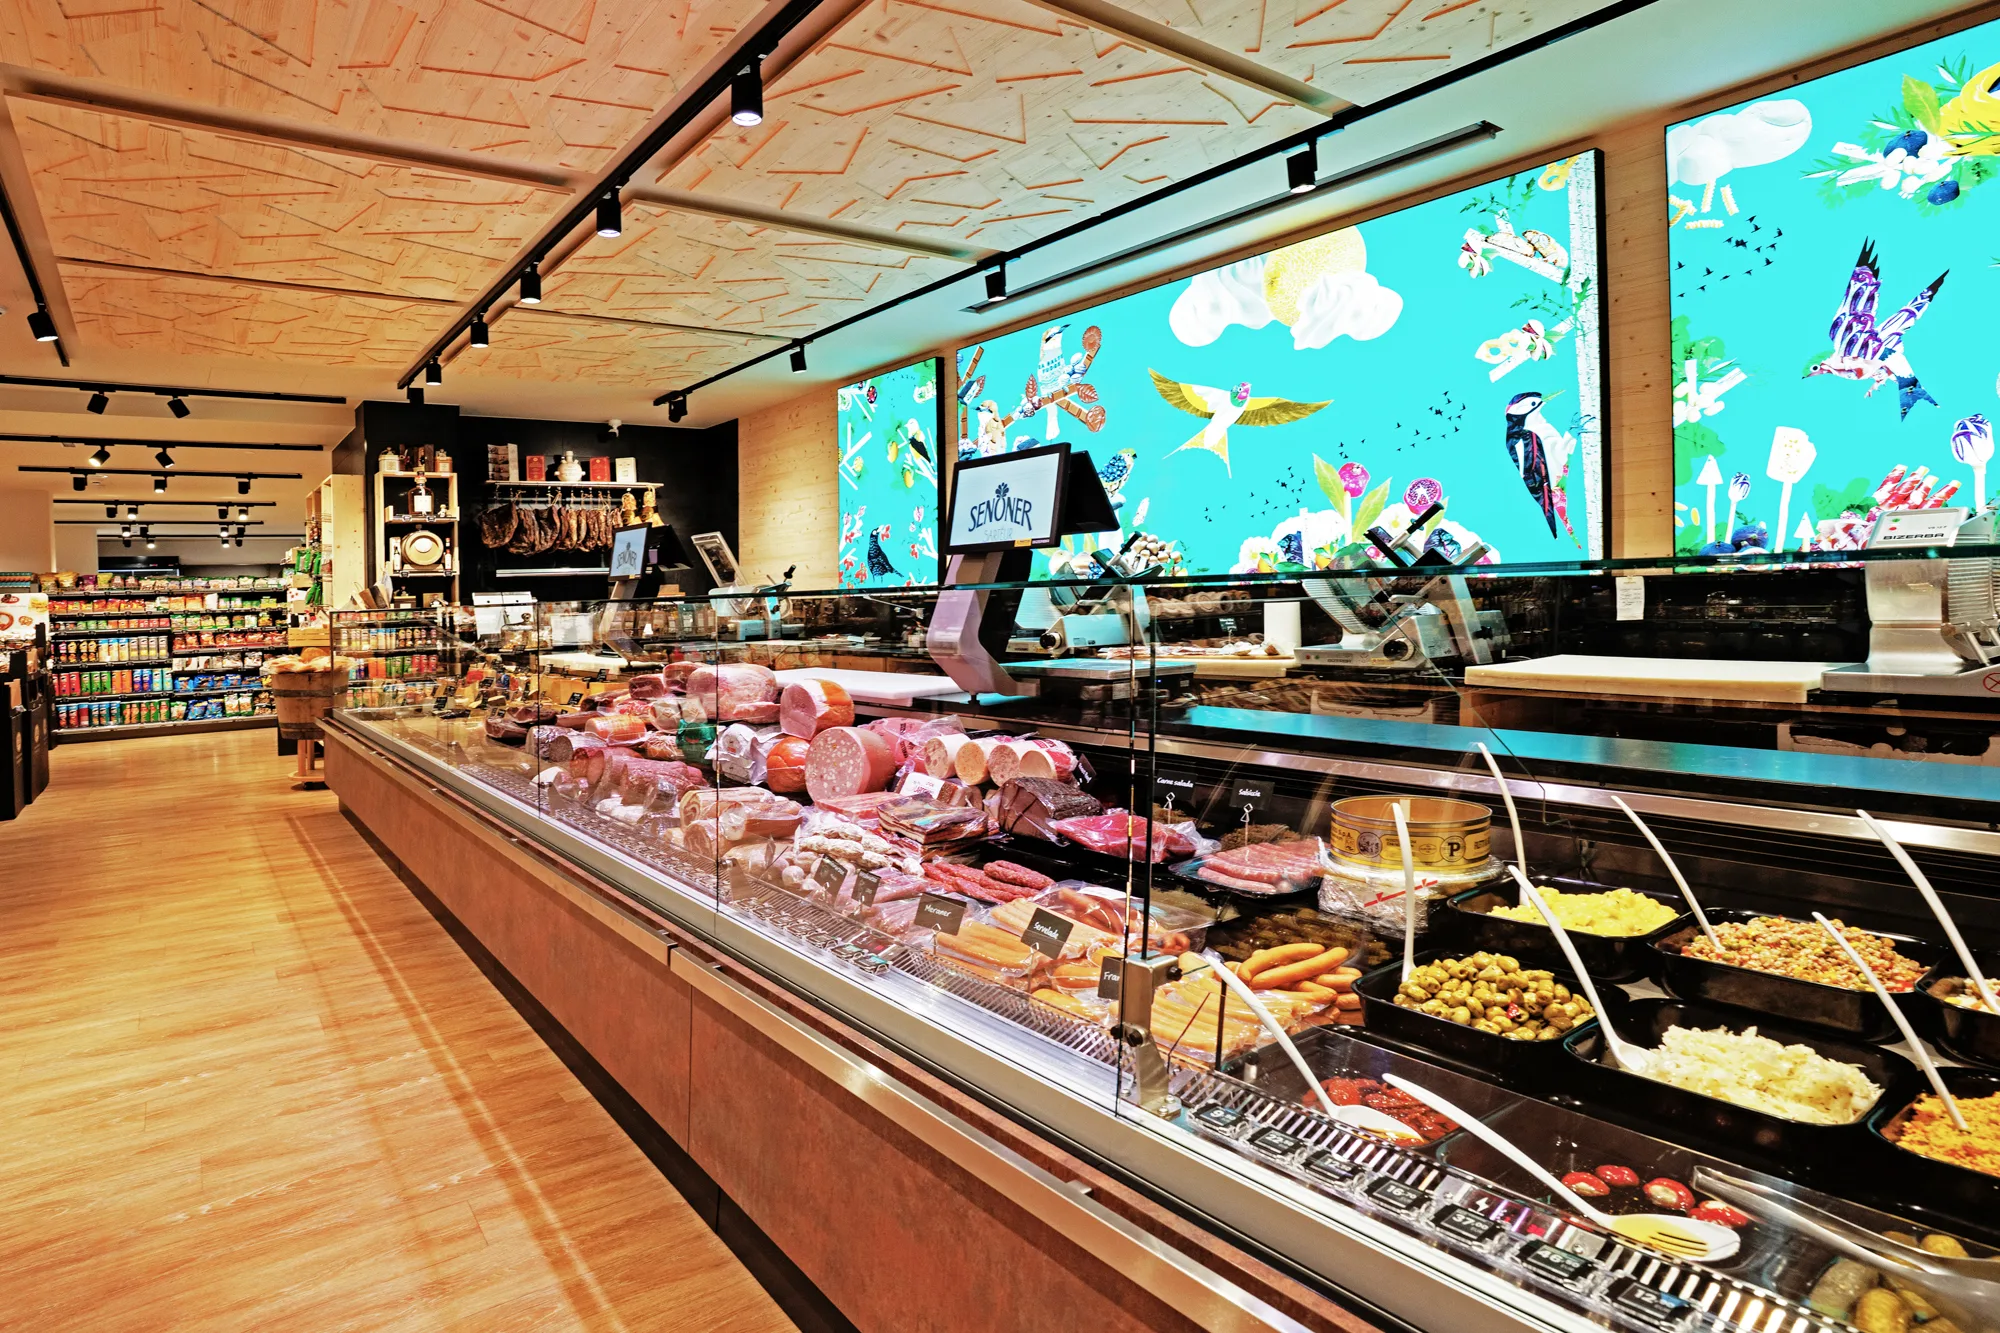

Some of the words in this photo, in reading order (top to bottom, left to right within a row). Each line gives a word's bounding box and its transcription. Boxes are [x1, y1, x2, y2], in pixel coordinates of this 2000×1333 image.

[968, 496, 1032, 532] SENONER
[1156, 777, 1173, 785] Carne
[1173, 779, 1194, 788] salada
[1447, 842, 1461, 857] P
[924, 903, 952, 917] Meraner
